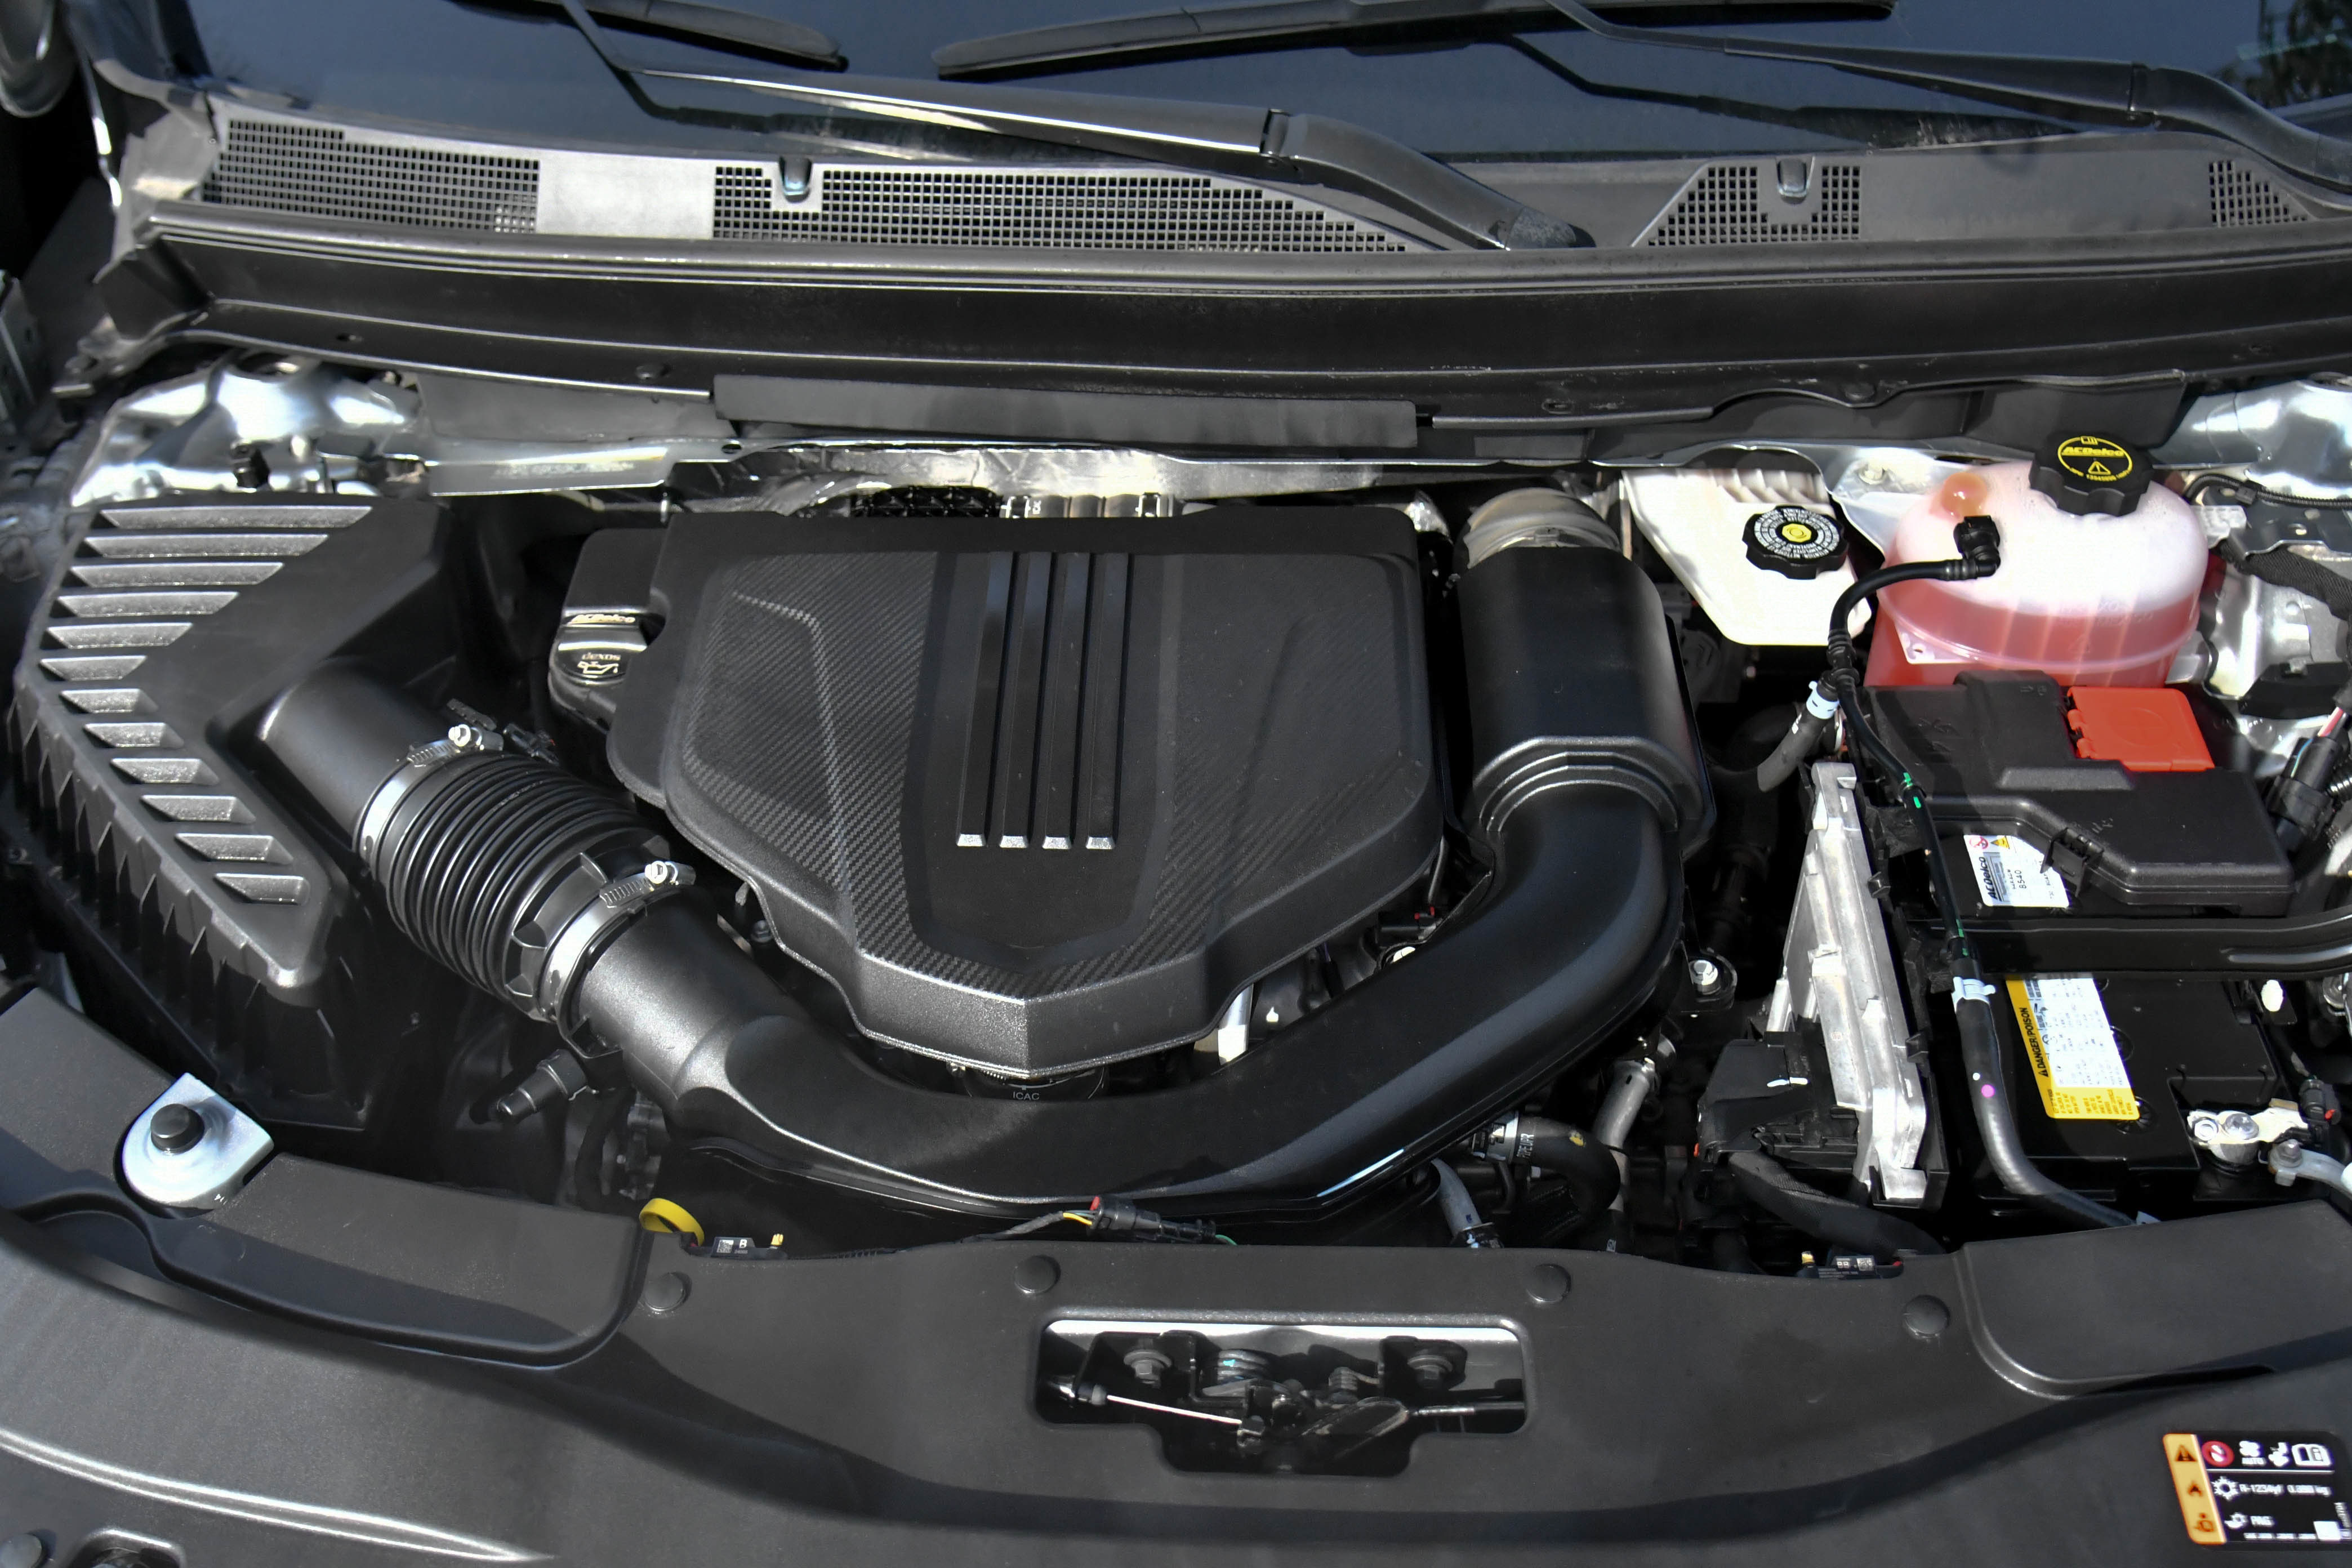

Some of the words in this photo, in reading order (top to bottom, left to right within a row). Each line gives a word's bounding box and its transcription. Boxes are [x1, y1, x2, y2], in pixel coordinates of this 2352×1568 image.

[2062, 447, 2125, 456] ACDelco
[581, 652, 621, 661] dexos
[1979, 856, 2000, 900] ACDelco
[2020, 1007, 2046, 1070] DANGER/POISON
[1013, 1091, 1040, 1100] ICAC
[740, 1239, 747, 1248] B
